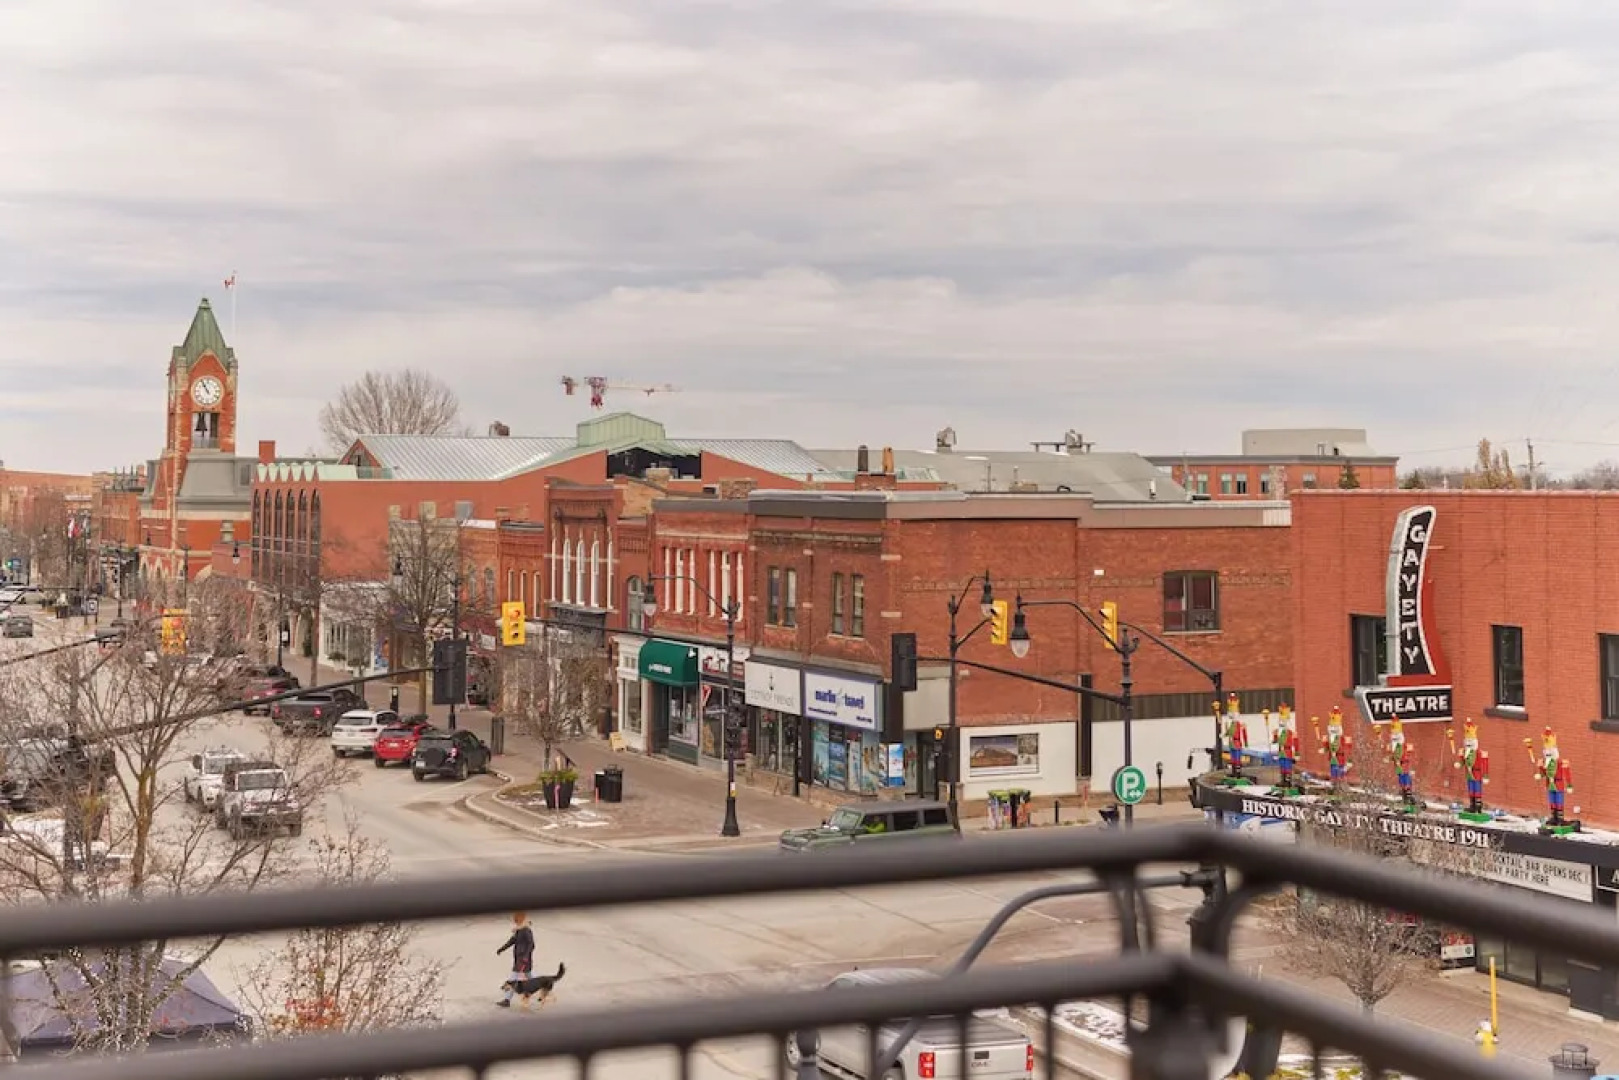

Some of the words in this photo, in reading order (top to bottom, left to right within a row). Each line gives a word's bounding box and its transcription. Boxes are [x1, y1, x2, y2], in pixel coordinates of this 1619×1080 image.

[1400, 524, 1426, 665] GAYETY
[1371, 695, 1449, 714] THEATRE
[1242, 799, 1310, 821] HISTORIC
[1379, 818, 1456, 843] THEATRE
[1460, 829, 1490, 848] 1911
